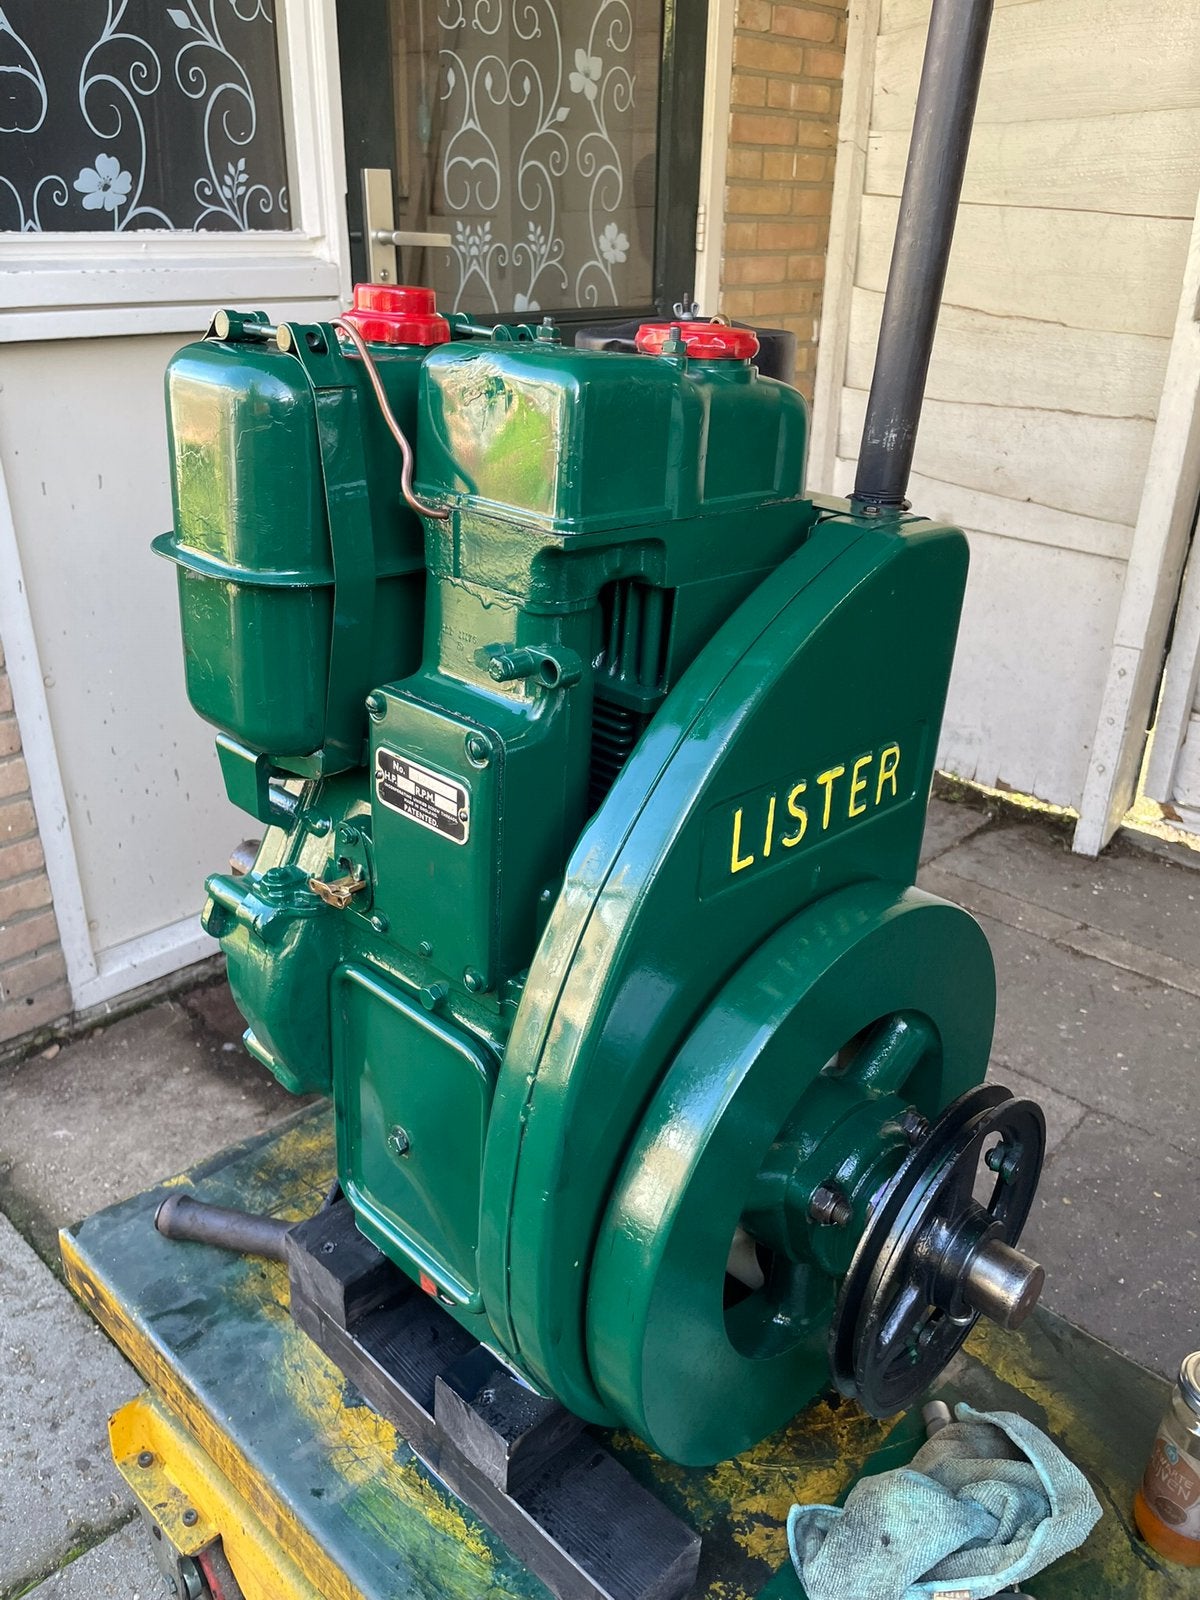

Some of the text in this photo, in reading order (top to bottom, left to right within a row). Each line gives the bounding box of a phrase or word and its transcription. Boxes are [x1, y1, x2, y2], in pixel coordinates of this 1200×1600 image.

[392, 760, 406, 775] No.
[384, 770, 398, 785] H.P.
[403, 804, 438, 828] PATENTED.
[731, 744, 901, 874] LISTER
